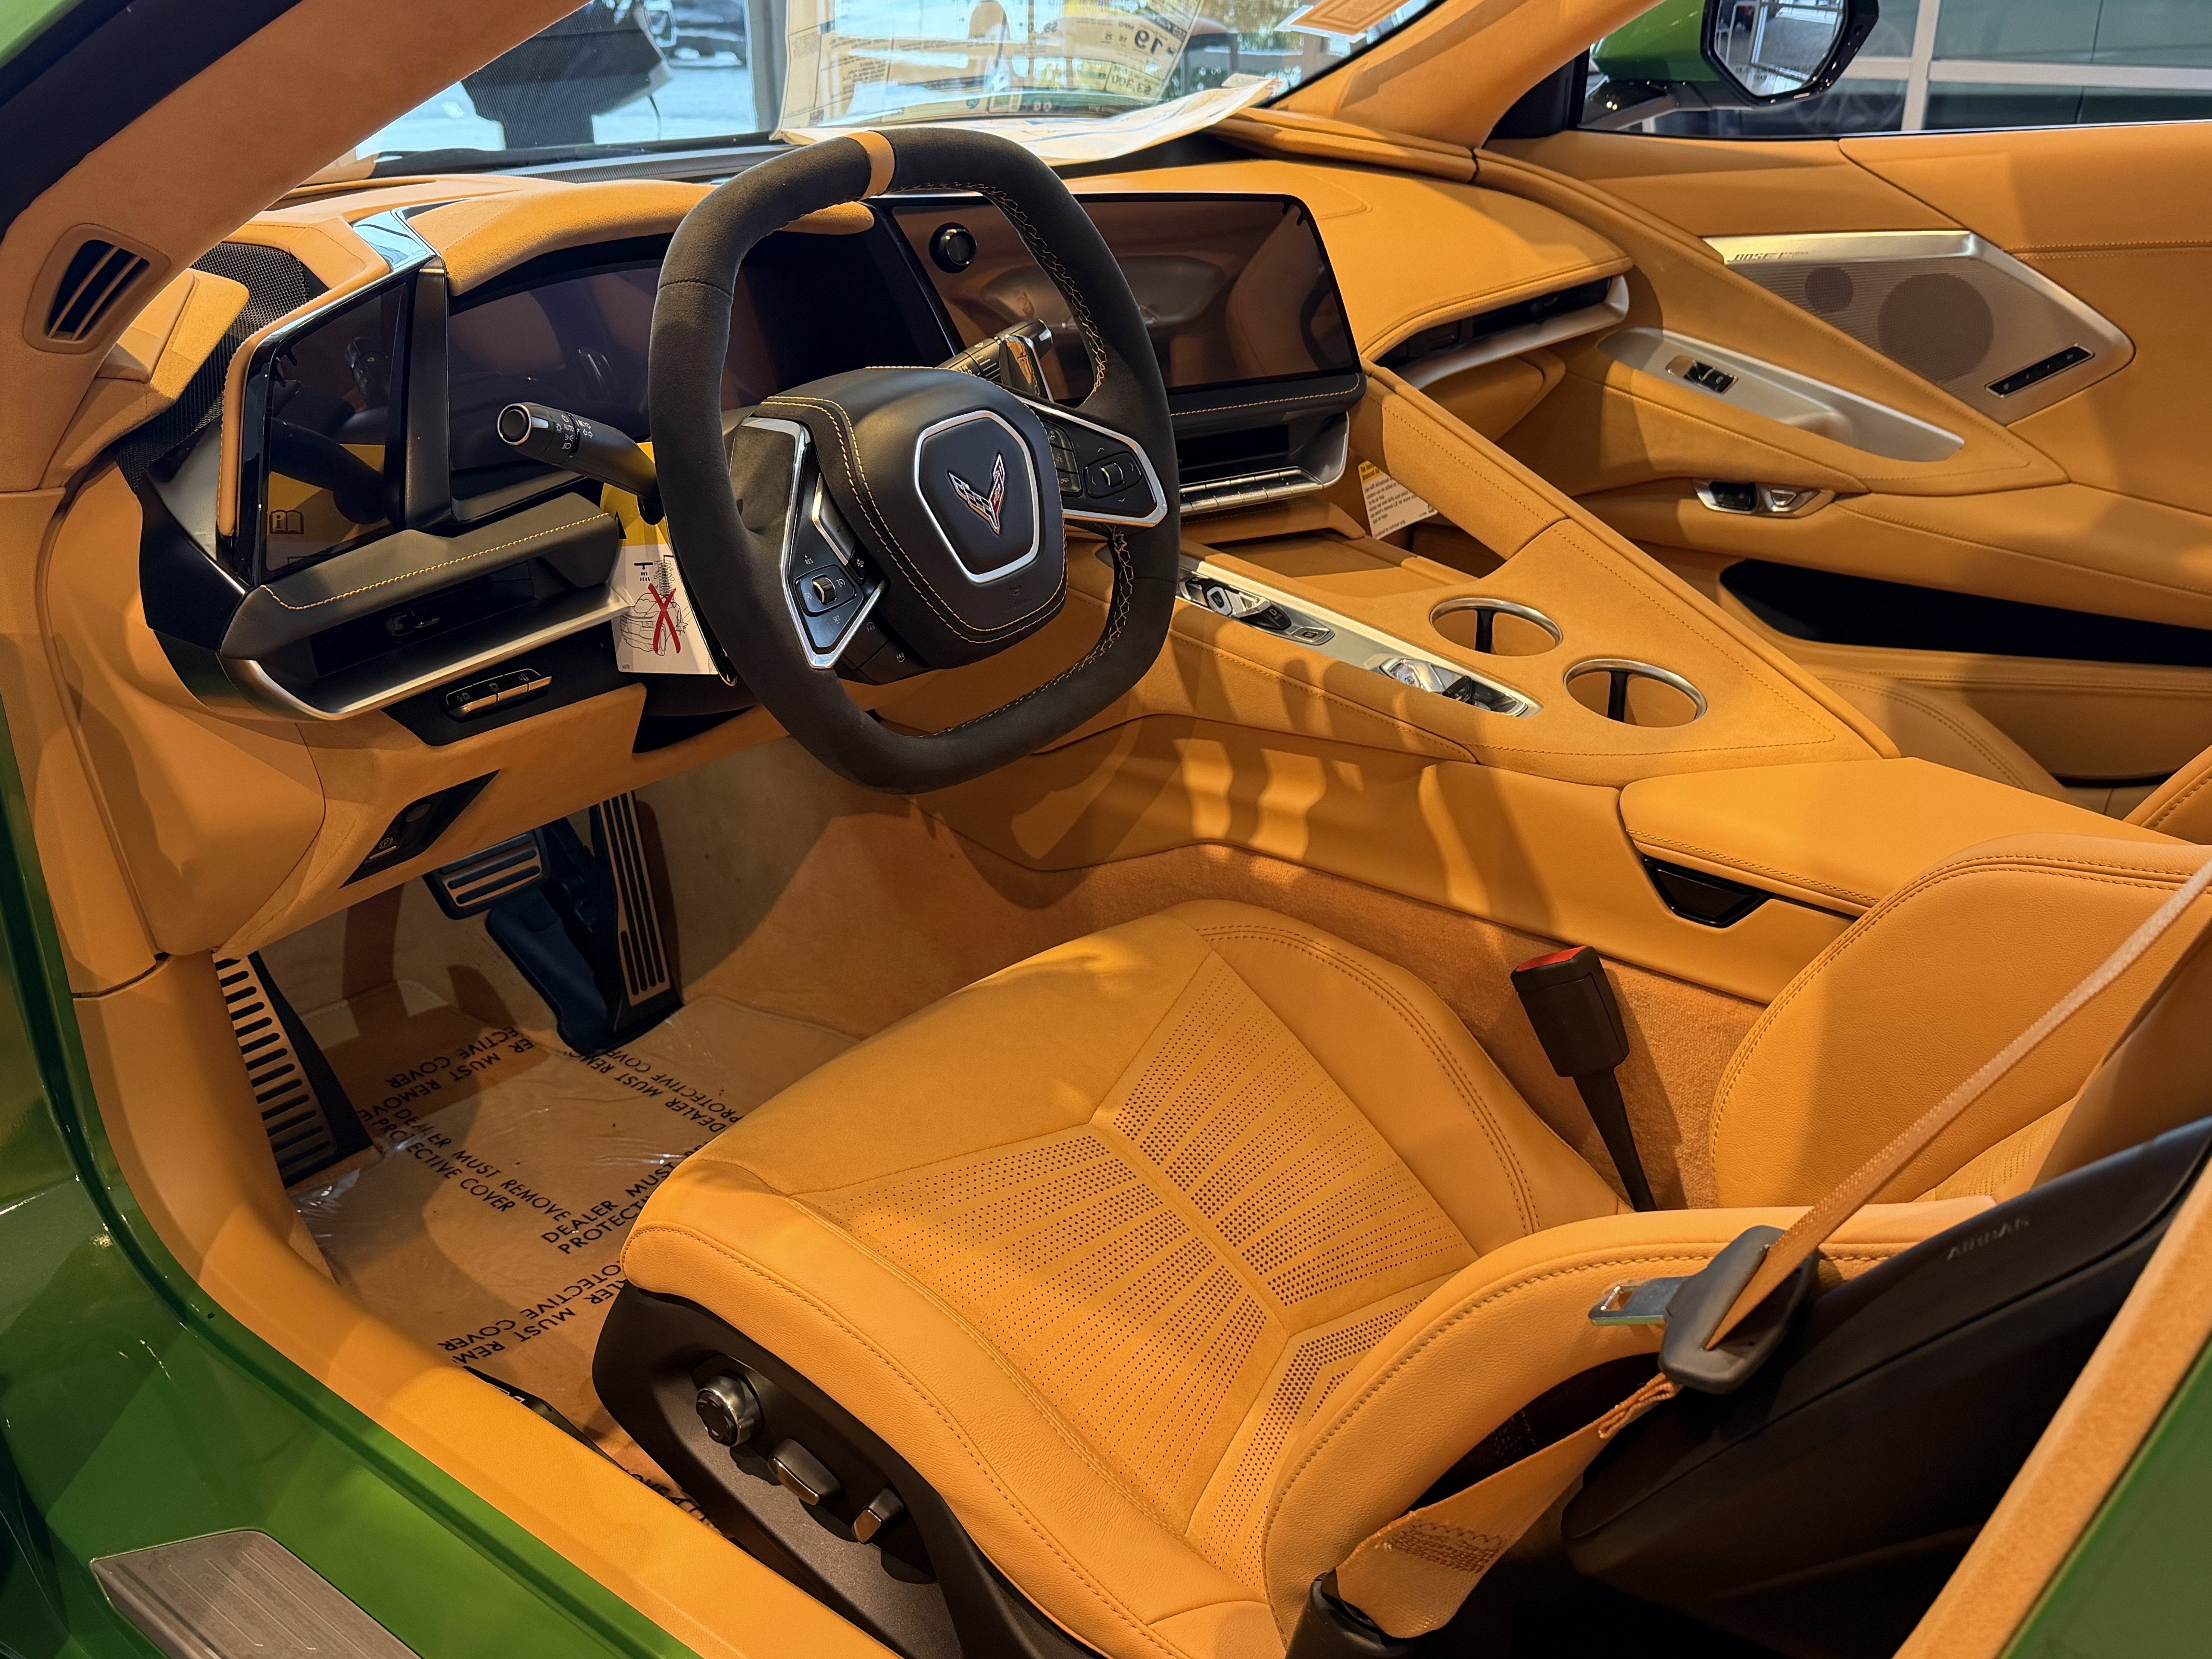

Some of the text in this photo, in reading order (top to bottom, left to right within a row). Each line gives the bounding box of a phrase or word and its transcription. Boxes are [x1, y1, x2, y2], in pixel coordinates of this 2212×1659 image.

[455, 1027, 519, 1060] ECTIVE
[357, 1053, 501, 1121] MUST REMOVE
[385, 1056, 451, 1089] COVER
[614, 1072, 663, 1097] MUST
[651, 1073, 745, 1123] PROTECTIVE
[665, 1097, 726, 1133] DEALER
[451, 1149, 501, 1178] MUST
[500, 1179, 571, 1222] REMOVE
[460, 1178, 515, 1212] COVER
[541, 1162, 676, 1243] DEALER MUST
[437, 1261, 621, 1352] OTECTIVE COVER
[514, 1307, 576, 1342] MUST
[452, 1341, 505, 1364] REM
